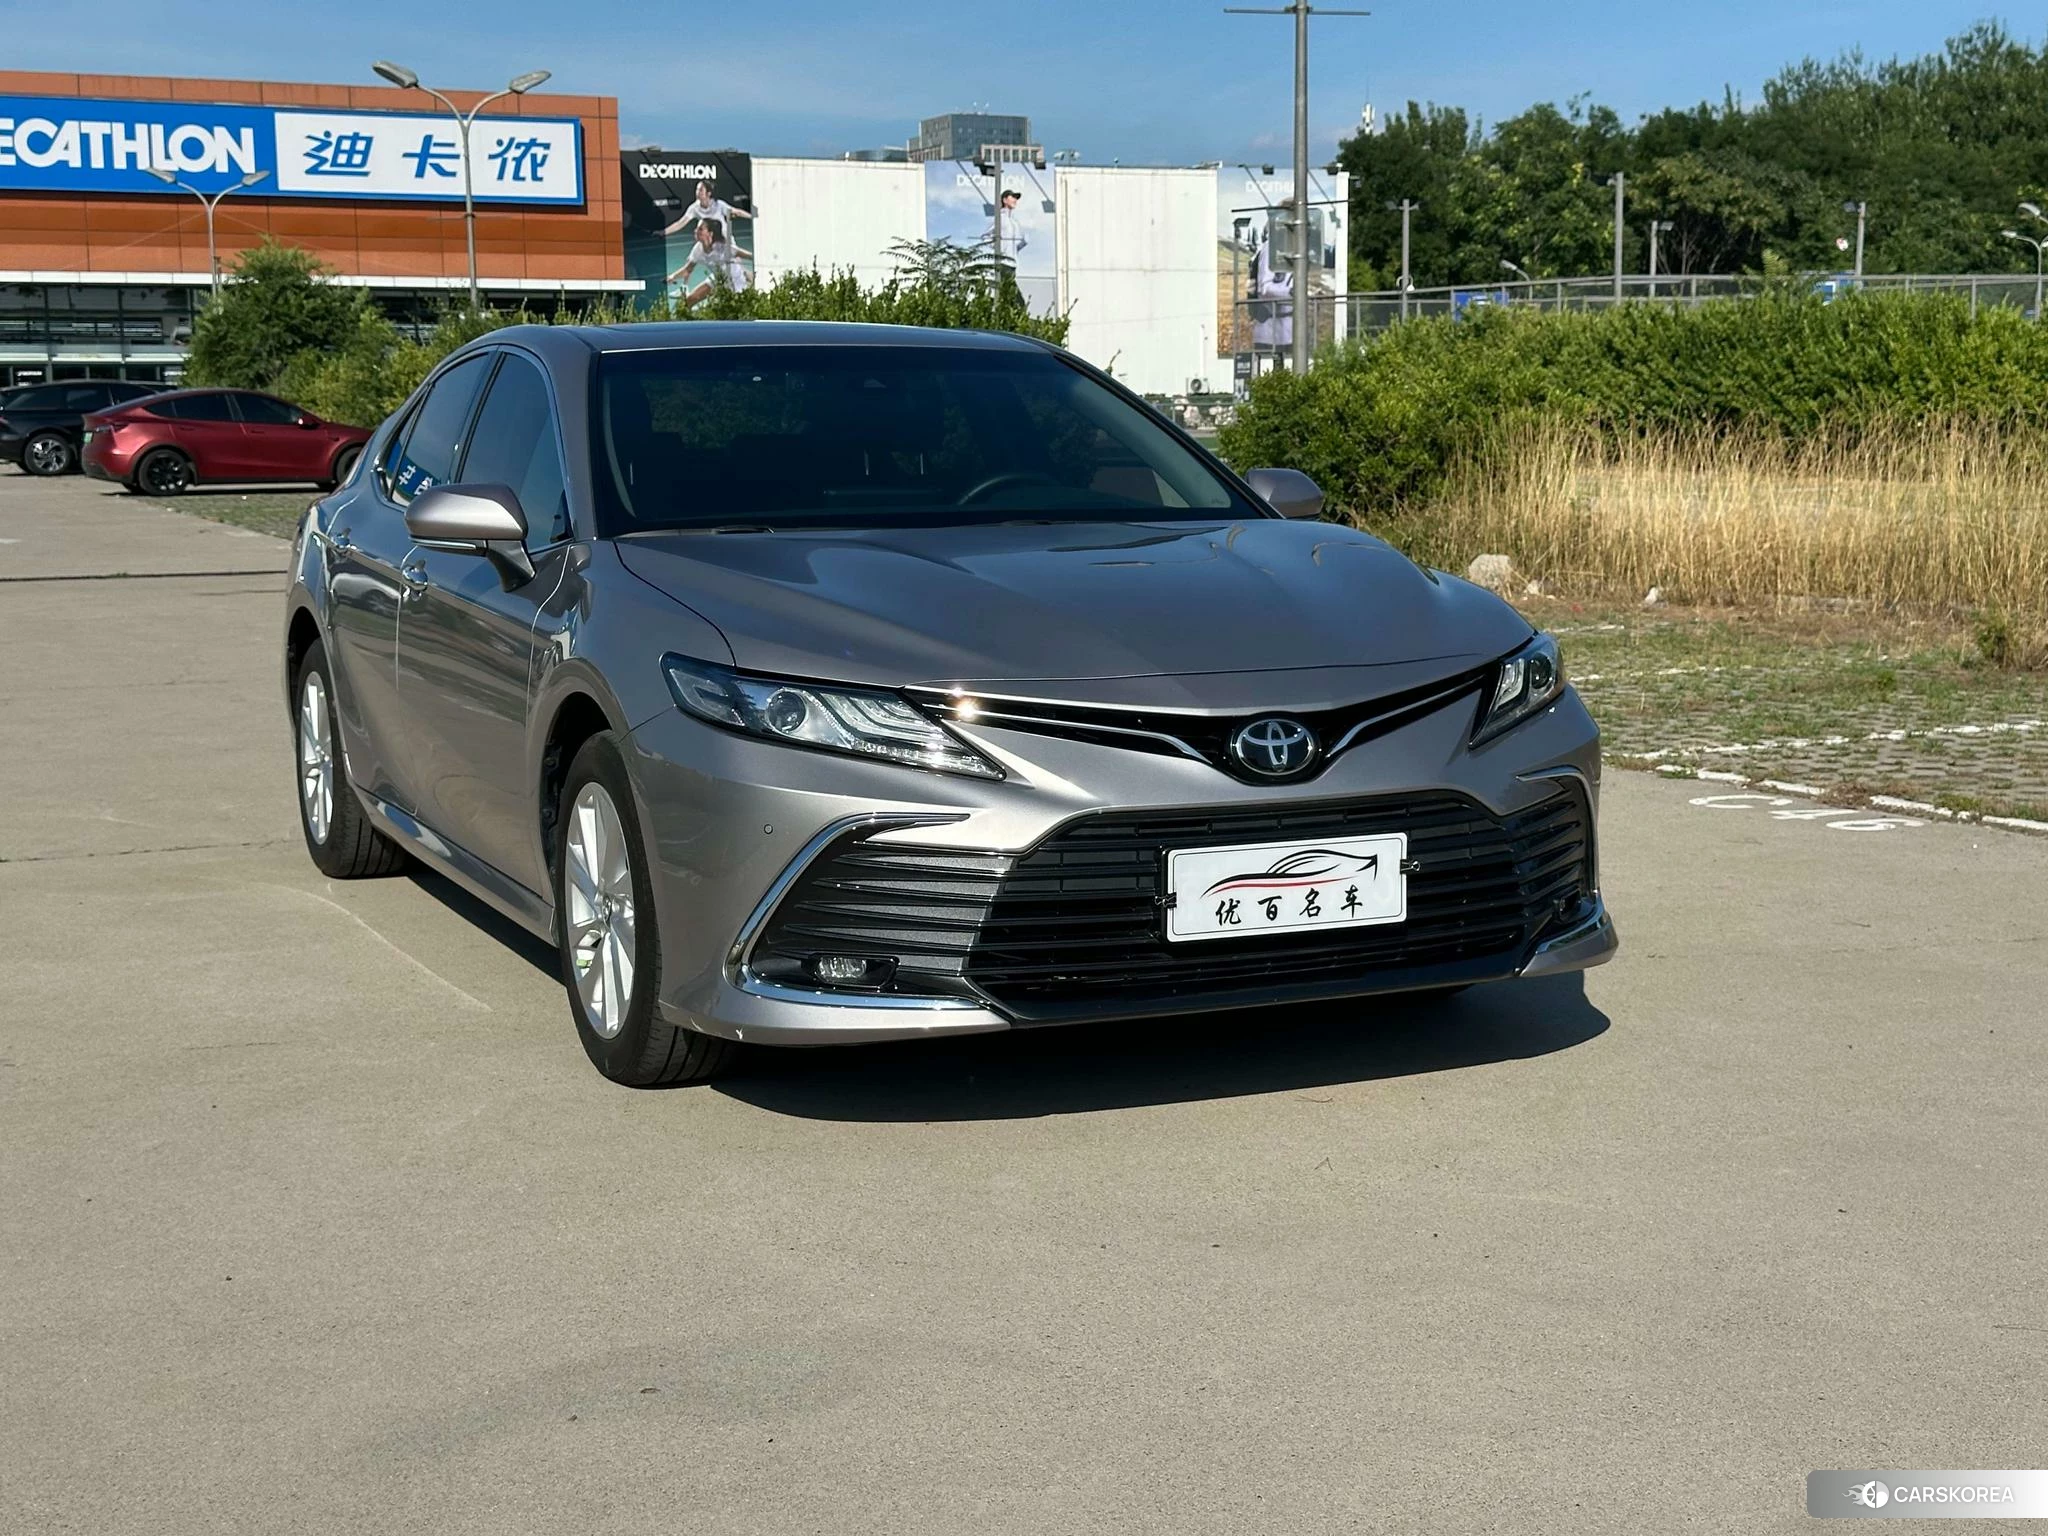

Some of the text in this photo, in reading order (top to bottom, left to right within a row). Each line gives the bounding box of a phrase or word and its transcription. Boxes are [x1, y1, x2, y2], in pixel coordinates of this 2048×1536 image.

[303, 131, 551, 182] 迪卡侬
[640, 164, 717, 179] DECATHLON
[1215, 885, 1363, 926] 优百名车
